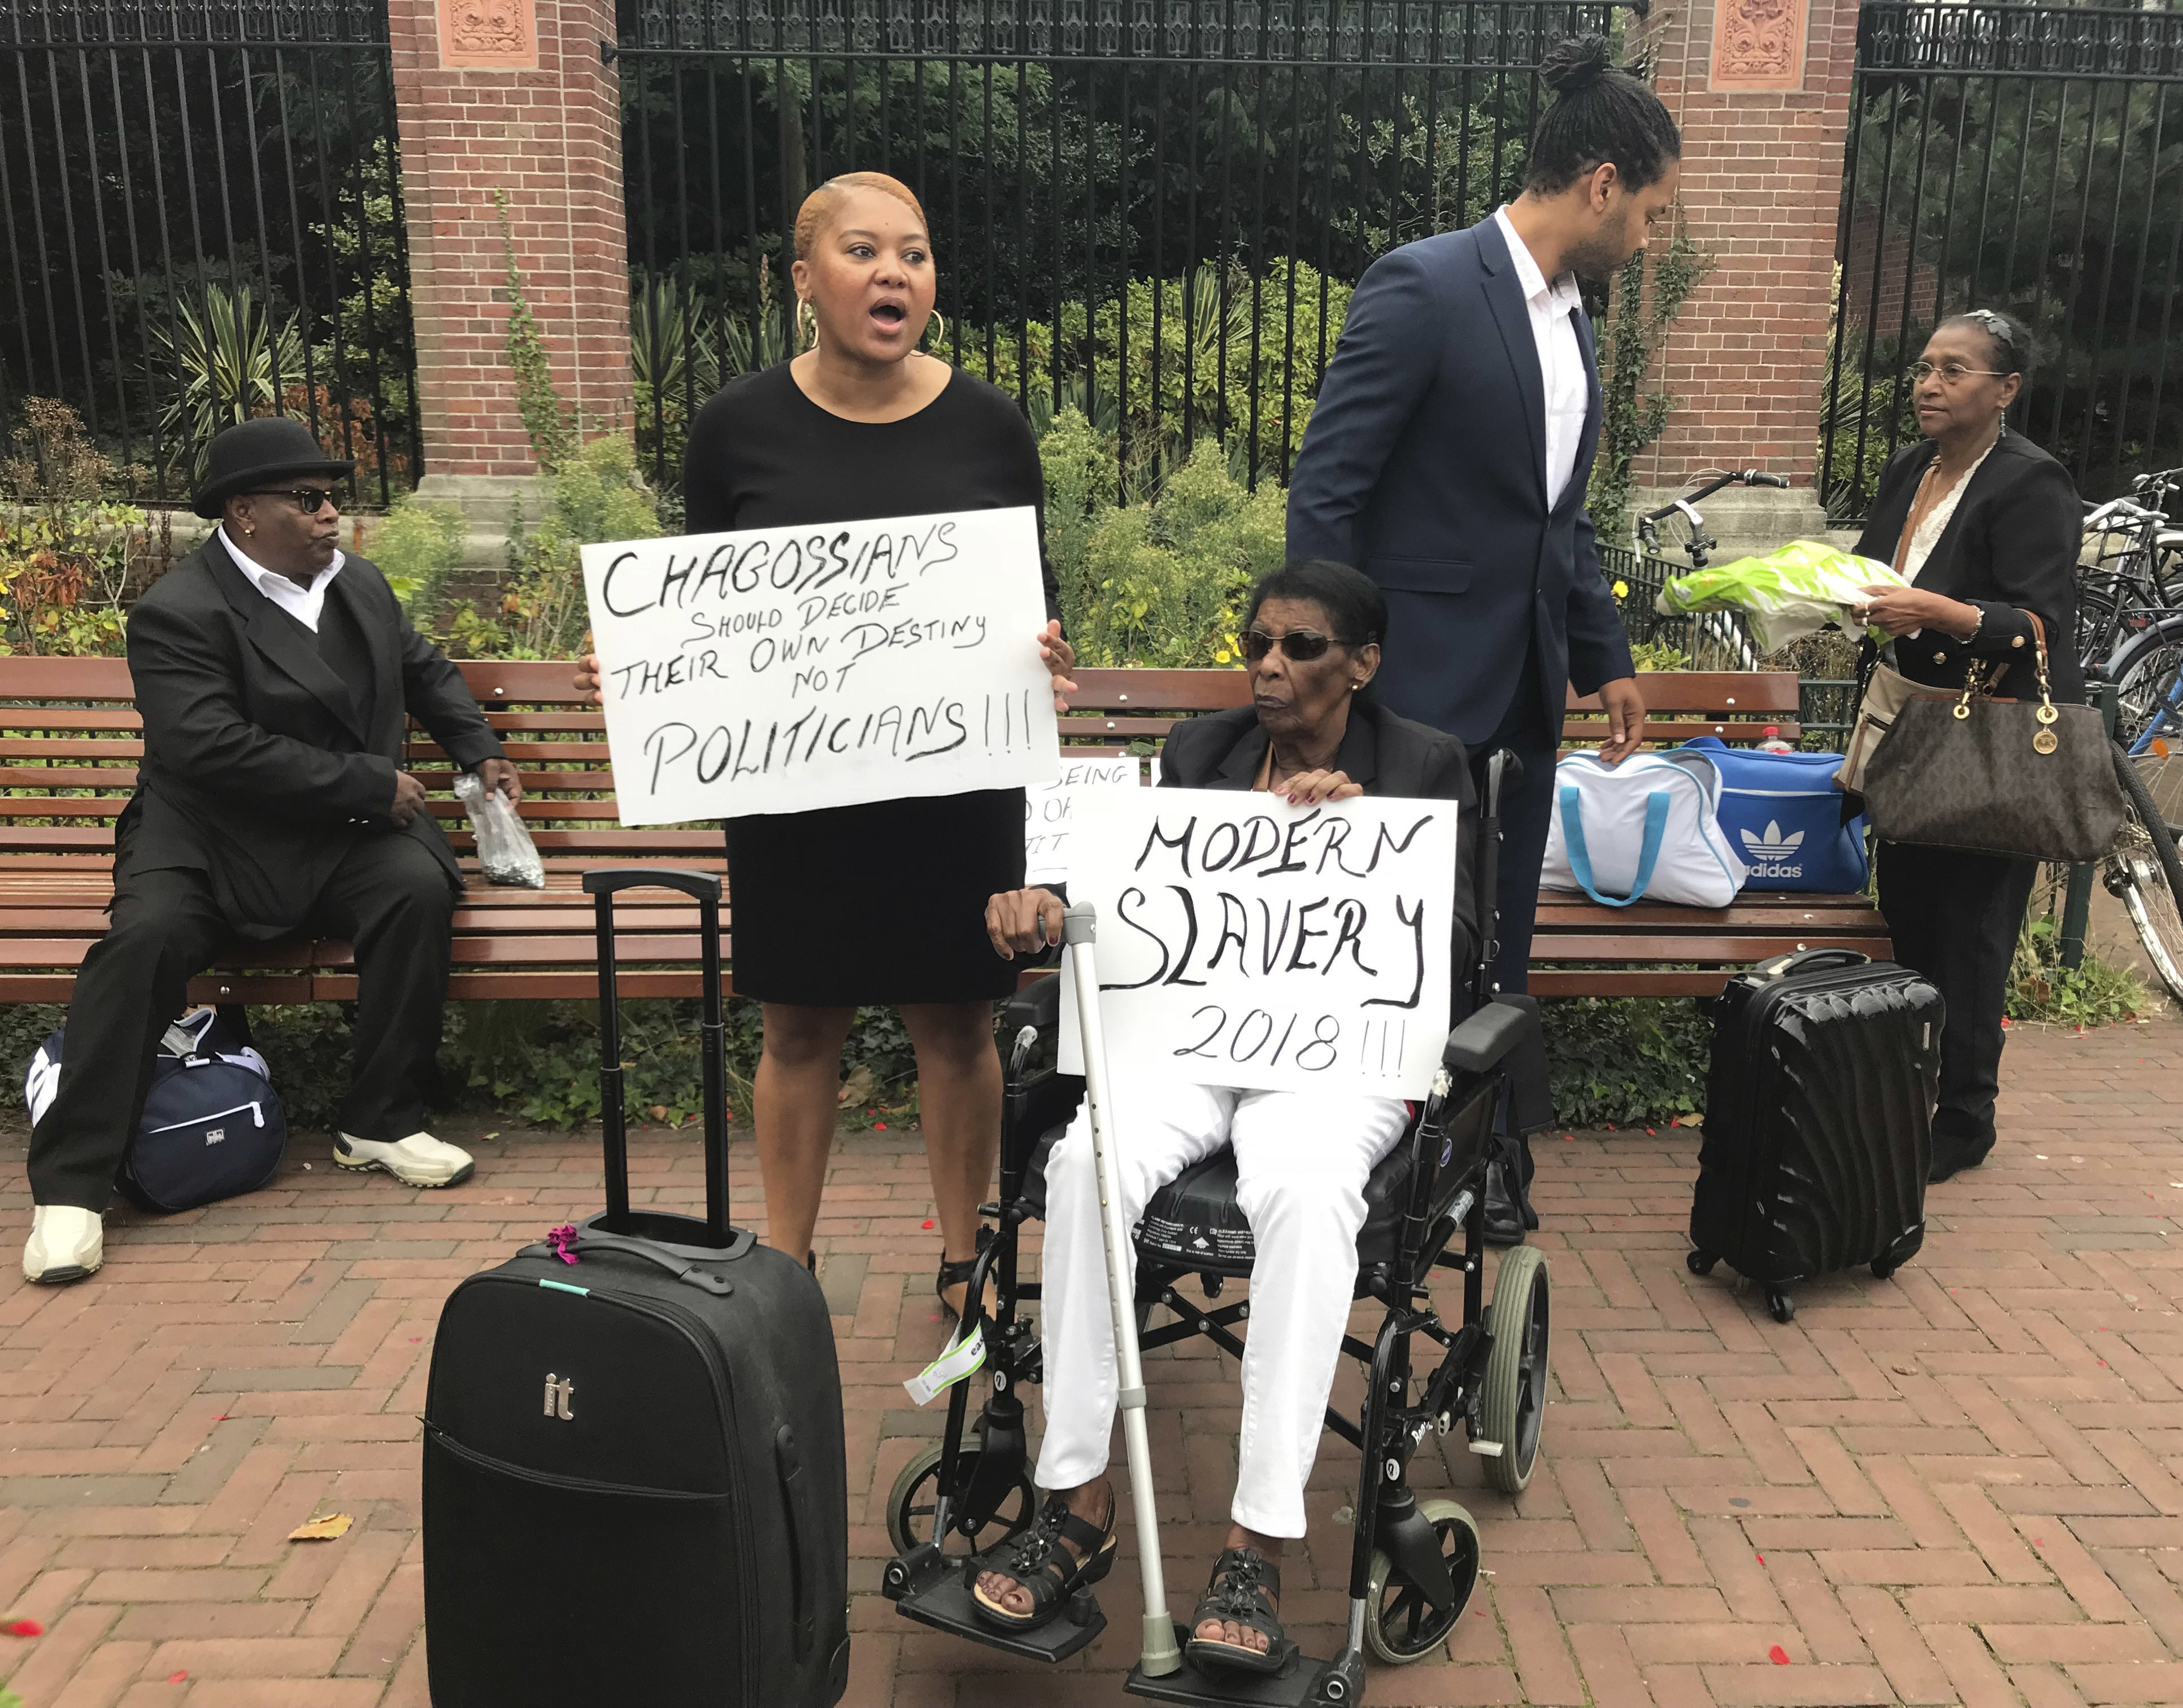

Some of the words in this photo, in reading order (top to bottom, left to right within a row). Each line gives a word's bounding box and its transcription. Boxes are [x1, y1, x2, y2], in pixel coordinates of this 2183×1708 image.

[602, 521, 959, 618] CHAGOSSIANS
[680, 608, 782, 649] SHOULD
[797, 582, 910, 631] DECIDE
[610, 650, 729, 700] THEIR
[749, 634, 830, 673] OWN
[840, 615, 986, 660] DESTINY
[792, 661, 856, 699] NOT
[1134, 808, 1434, 879] MODERN
[1098, 884, 1425, 1010] SLAVERY
[543, 1372, 574, 1421] it
